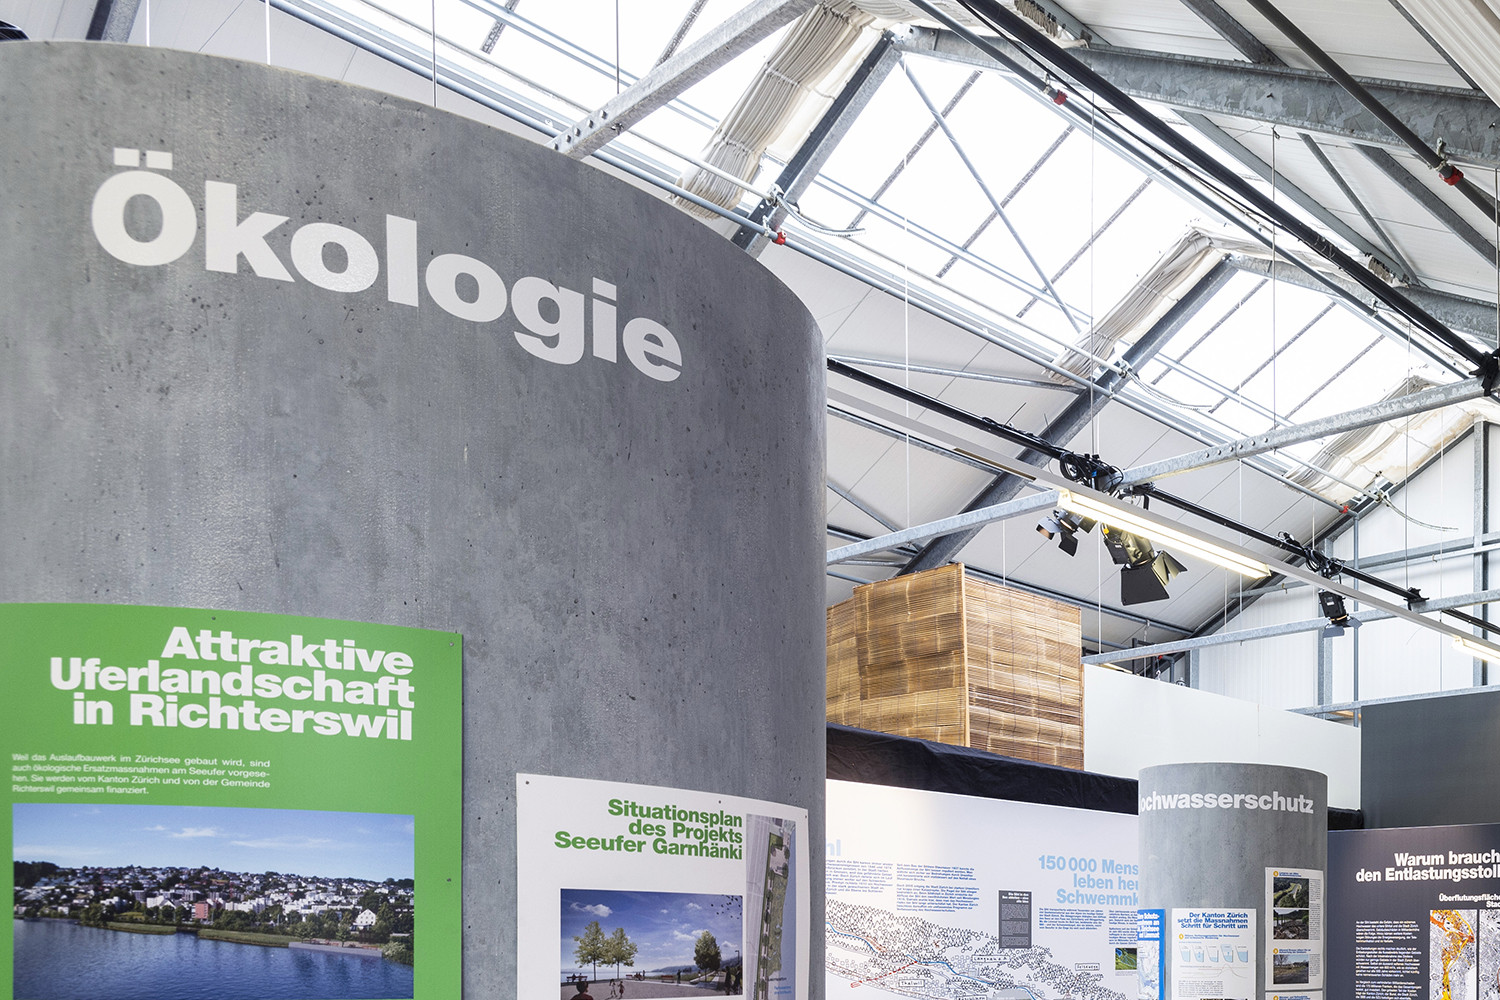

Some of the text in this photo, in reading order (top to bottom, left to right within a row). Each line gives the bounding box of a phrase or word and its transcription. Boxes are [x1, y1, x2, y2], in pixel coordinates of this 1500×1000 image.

[91, 147, 683, 382] Ökologie
[160, 626, 414, 676] Attraktive
[50, 657, 415, 709] Uferlandschaft
[74, 692, 412, 741] in Richterswil
[50, 753, 270, 768] Auslaufbauwerk im Zürichsee gebaut wird, sind
[82, 764, 170, 773] Ersatzmassnahmen
[188, 766, 225, 775] Seeufer
[227, 770, 270, 778] vorgese-
[97, 774, 129, 782] Kanton
[131, 775, 160, 783] Zürich
[162, 776, 180, 784] und
[202, 777, 217, 785] der
[220, 778, 270, 788] Gemeinde
[608, 799, 742, 828] Situationsplan
[1139, 791, 1314, 814] ochwasserschutz
[629, 819, 742, 845] des Projekts
[554, 831, 743, 860] Seeufer Garnhänki
[1038, 854, 1066, 870] 150
[1068, 857, 1098, 872] 000
[1394, 852, 1444, 866] Warum
[1073, 873, 1114, 889] leben
[1356, 868, 1382, 882] den
